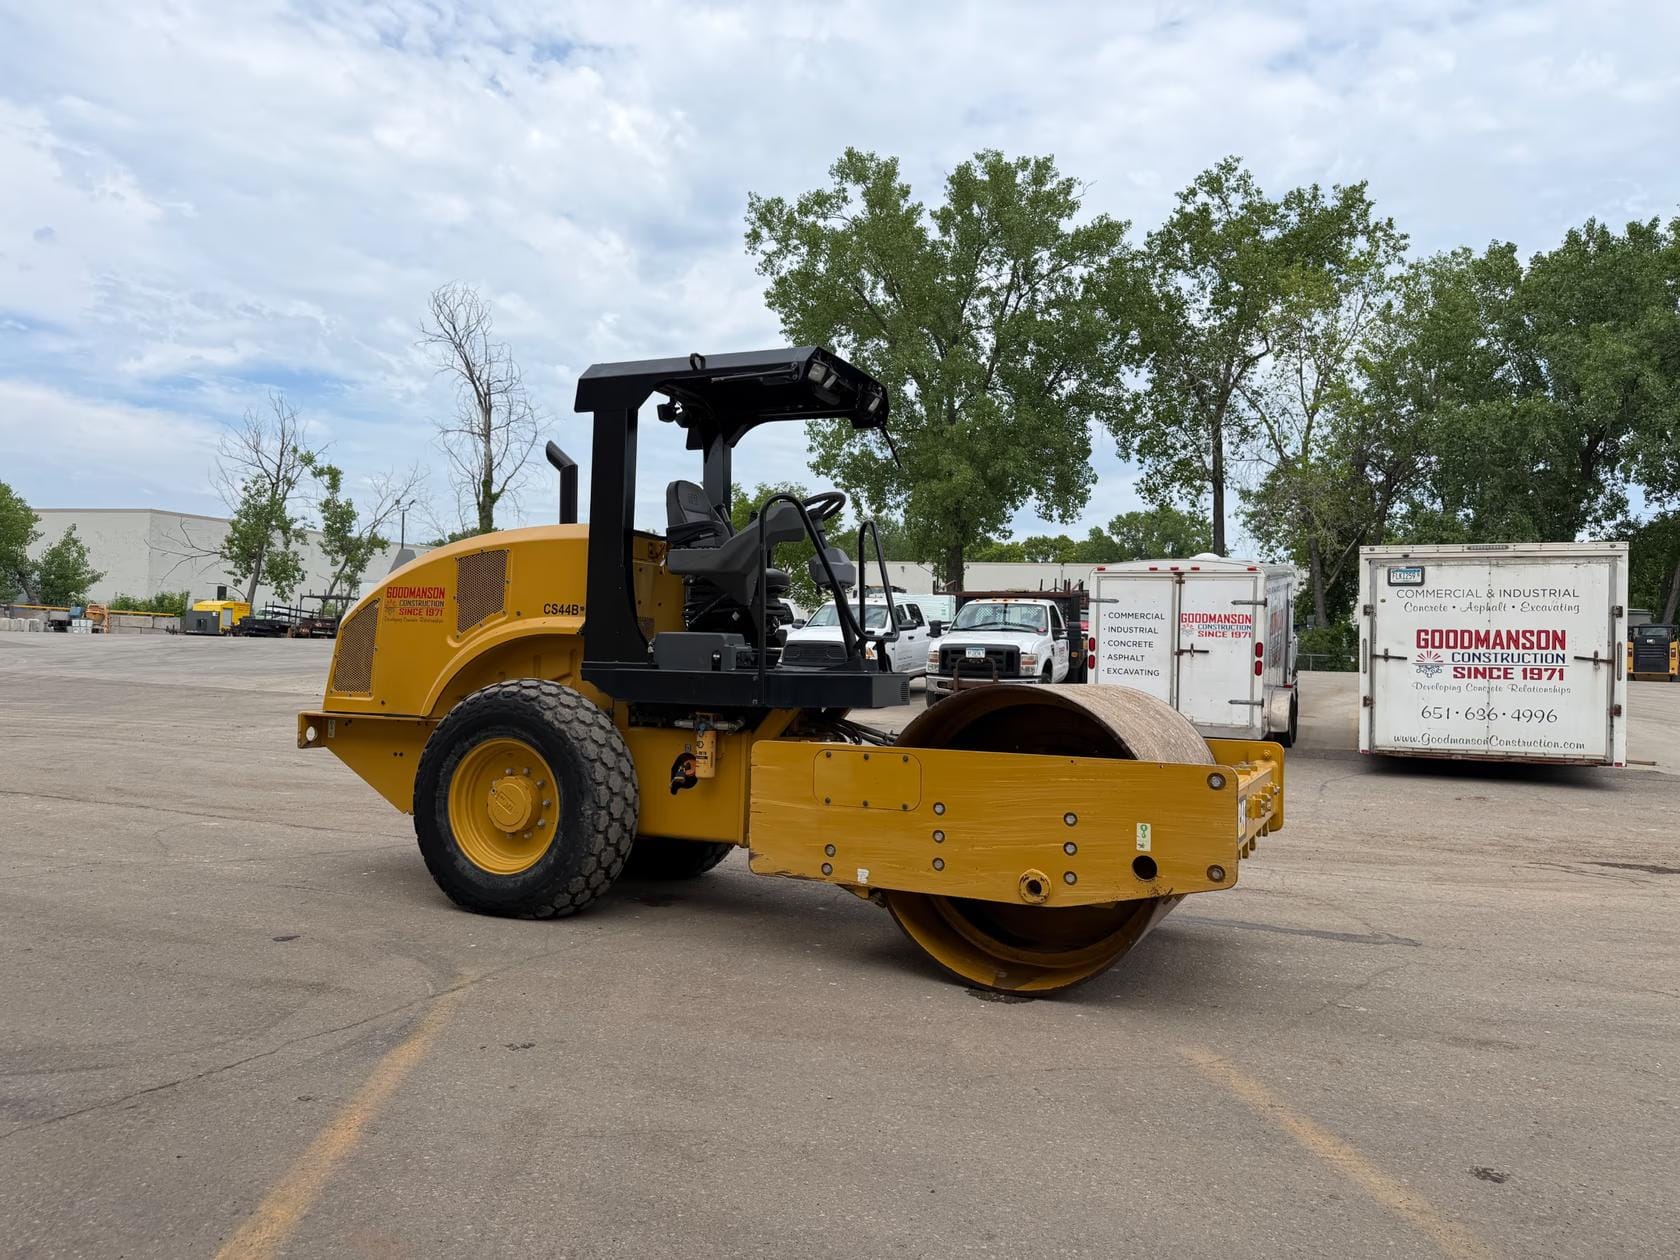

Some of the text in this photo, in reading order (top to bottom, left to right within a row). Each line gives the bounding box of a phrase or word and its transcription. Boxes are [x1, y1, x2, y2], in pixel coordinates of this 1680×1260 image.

[387, 586, 446, 599] GOODMANSON
[1396, 588, 1580, 599] COMMERCIAL & INDUSTRIAL
[399, 599, 445, 607] CONSTRUCTION
[1404, 601, 1580, 614] Concrete Asphalt Excavating
[399, 608, 443, 617] SINCE 1971
[543, 603, 579, 616] CS44B
[1108, 611, 1165, 620] COMMERCIAL
[1180, 613, 1252, 624] GOODMANSON
[1107, 625, 1159, 634] INDUSTRIAL
[1197, 623, 1252, 631] CONSTRUCTION
[1107, 639, 1154, 648] CONCRETE
[1416, 629, 1566, 651] GOODMANSON
[1107, 653, 1145, 662] ASPHALT
[1451, 651, 1566, 664] CONSTRUCTION
[1106, 667, 1160, 677] EXCAVATING
[1453, 666, 1564, 681] SINCE 1971
[1412, 682, 1571, 695] Developing Concrete Relationships
[1393, 732, 1585, 750] www.GoodmansonConstruction.com
